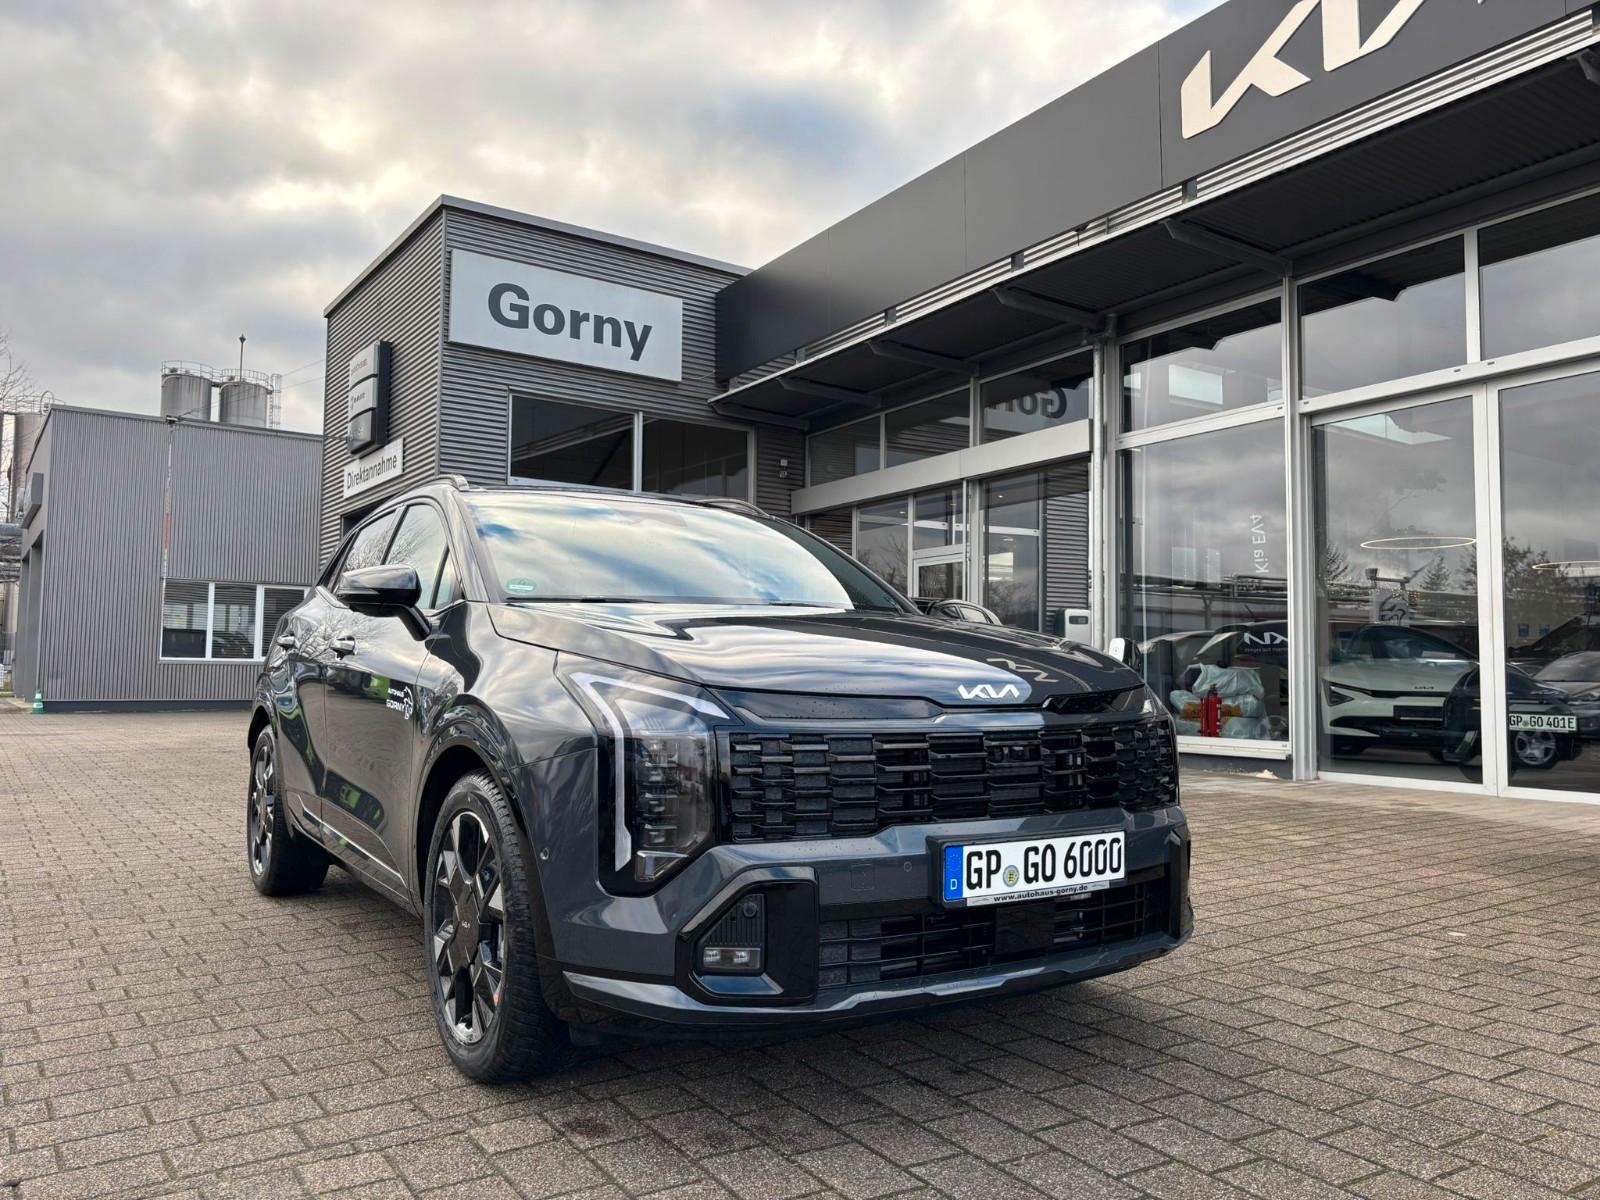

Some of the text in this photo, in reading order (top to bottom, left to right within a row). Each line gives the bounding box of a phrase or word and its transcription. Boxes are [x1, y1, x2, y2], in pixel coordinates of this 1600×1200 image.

[487, 282, 653, 362] Gorny
[347, 454, 397, 489] Direktannahme
[1249, 513, 1269, 573] Kia EV4
[957, 684, 1020, 699] KIA
[1509, 714, 1575, 729] GP GO 401E
[950, 837, 1122, 890] D GP GO 6000
[993, 884, 1088, 902] www.autohaus-gorny.de
